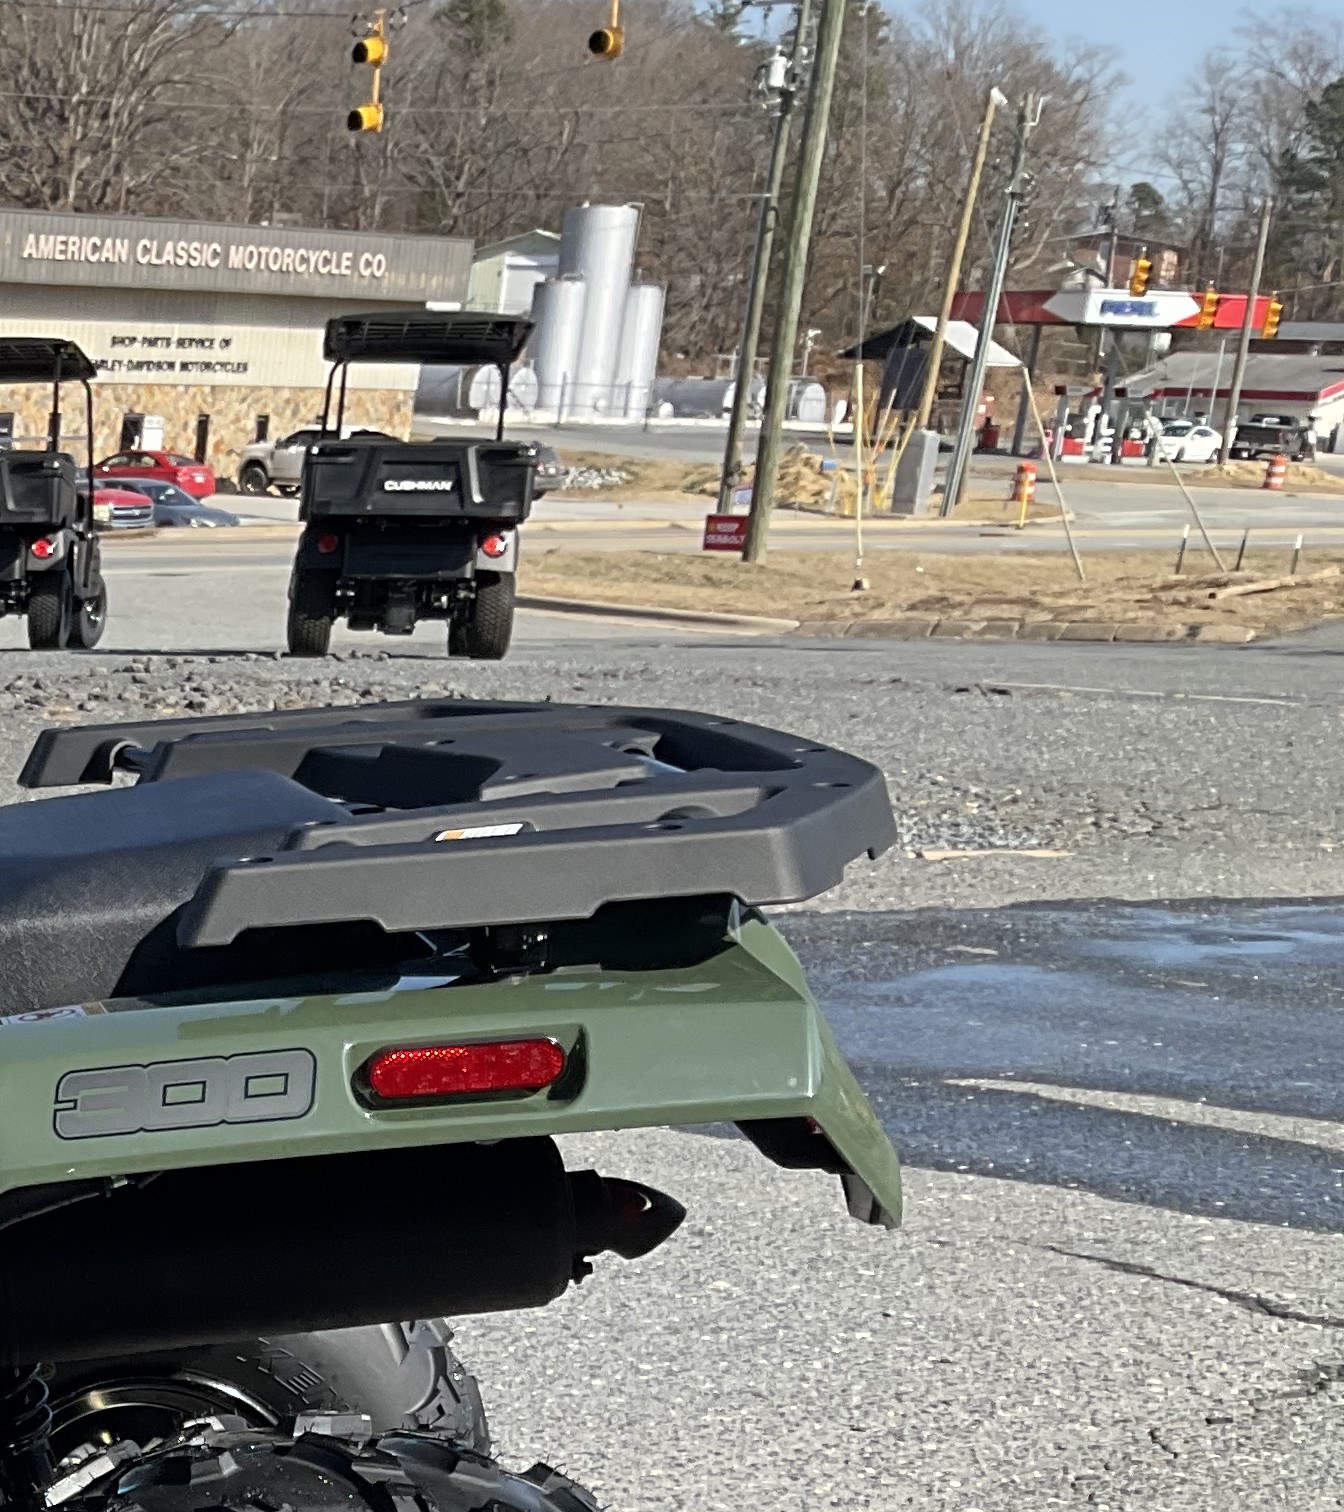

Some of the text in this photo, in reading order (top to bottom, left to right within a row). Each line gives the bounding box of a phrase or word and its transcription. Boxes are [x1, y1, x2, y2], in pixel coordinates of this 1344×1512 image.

[23, 233, 390, 278] AMERICAN CLASSIC MOTORCYCLE CO.
[91, 359, 177, 372] ARLEY-DAVIDSON
[384, 479, 453, 492] CUSHMAN
[53, 1047, 317, 1140] 300
